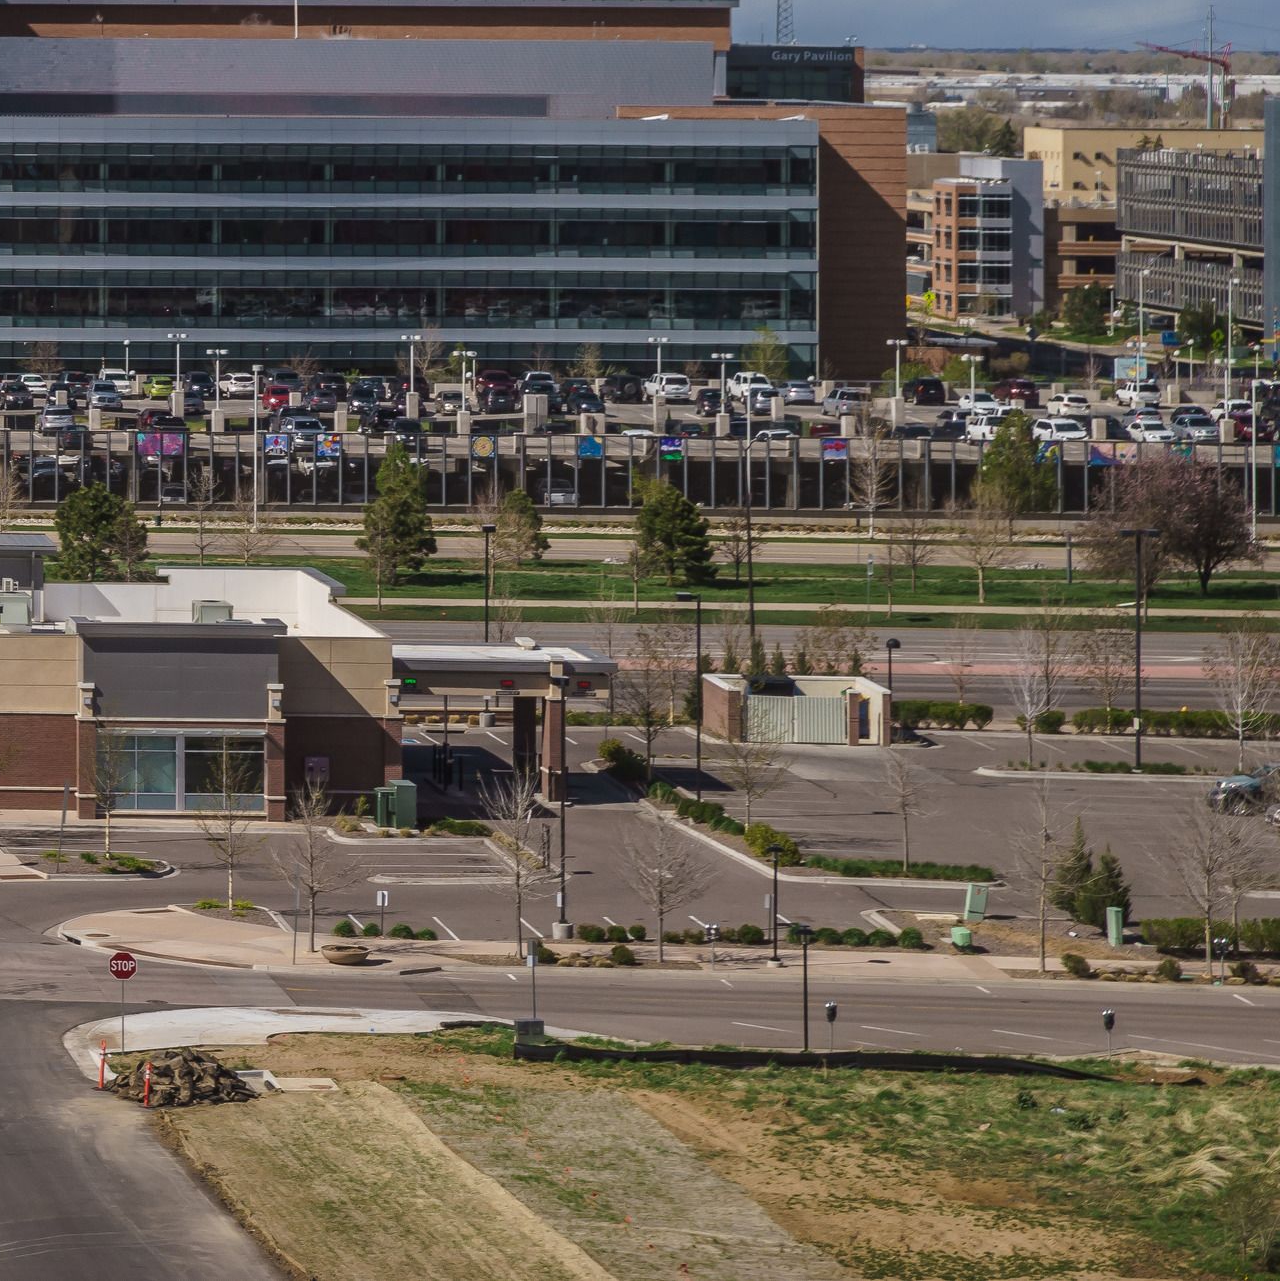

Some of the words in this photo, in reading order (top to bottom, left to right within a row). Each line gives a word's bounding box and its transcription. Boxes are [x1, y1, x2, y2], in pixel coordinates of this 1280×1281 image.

[771, 50, 800, 63] Gary
[803, 50, 853, 61] Pavilion
[111, 960, 135, 971] STOP
